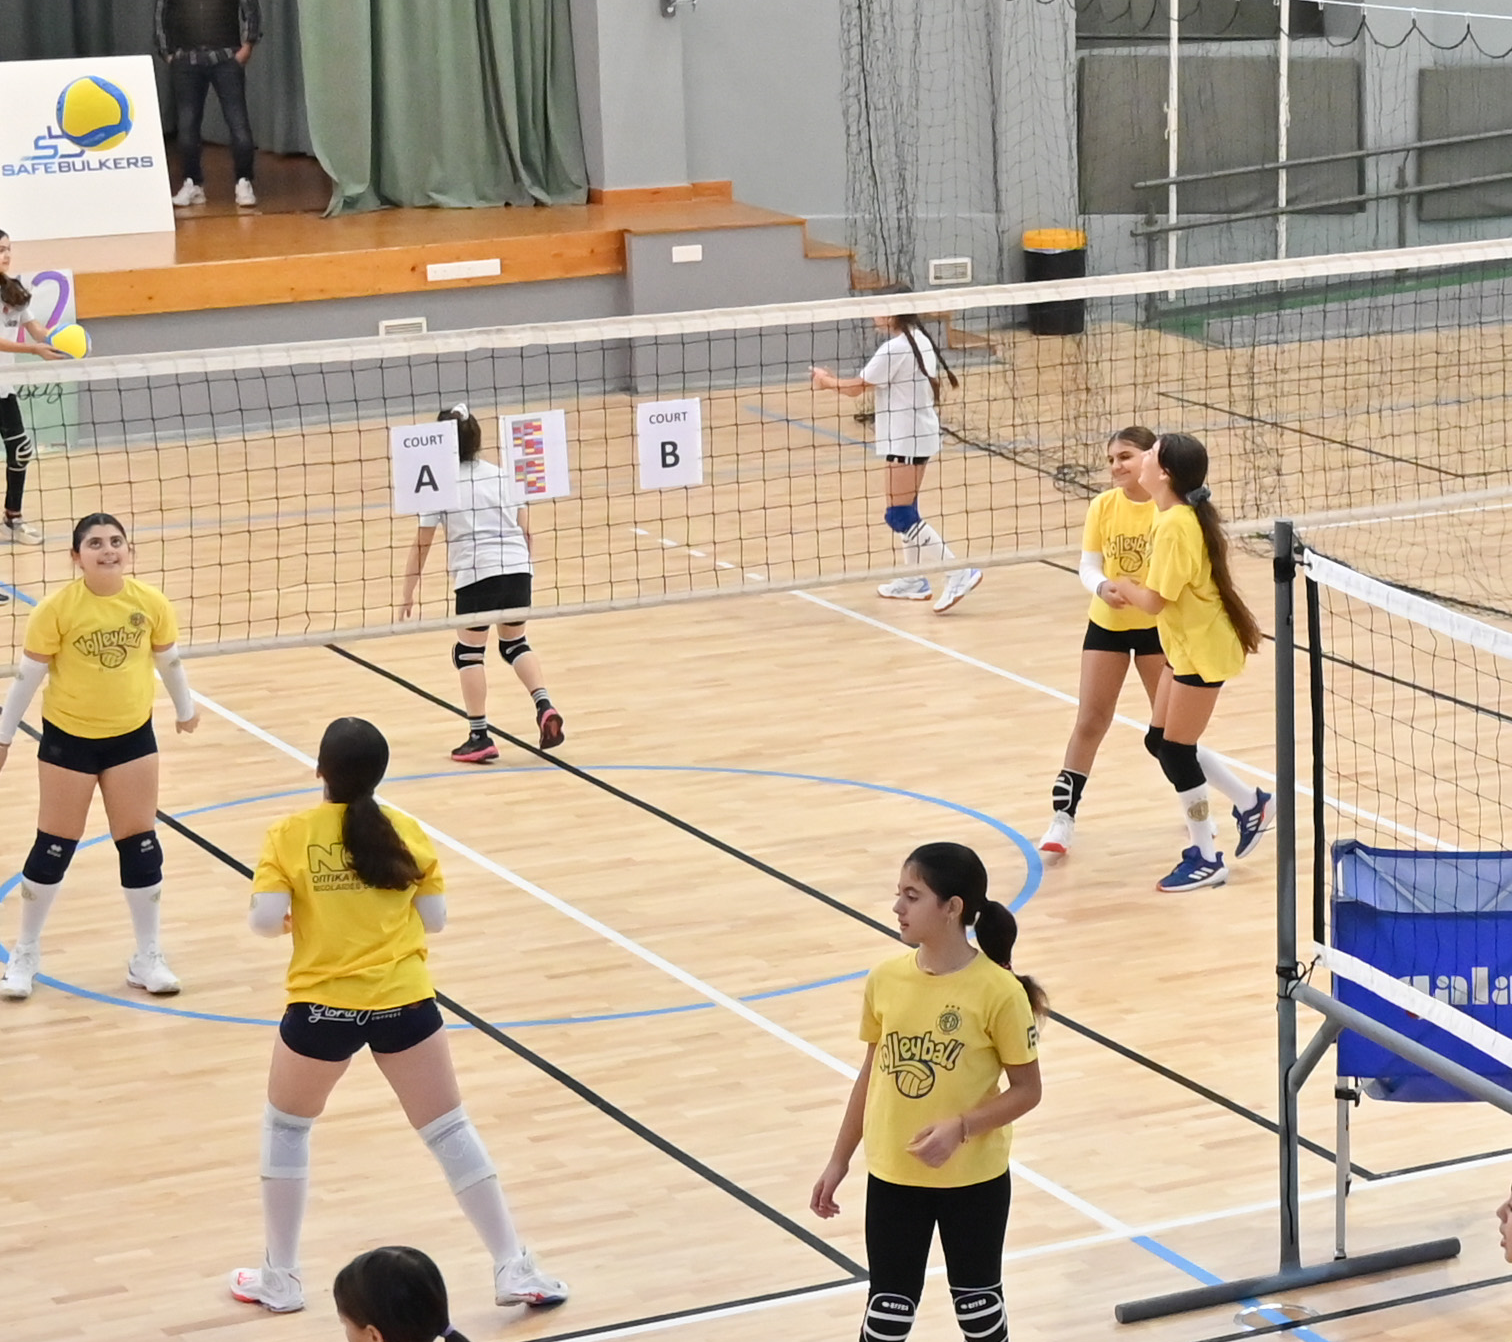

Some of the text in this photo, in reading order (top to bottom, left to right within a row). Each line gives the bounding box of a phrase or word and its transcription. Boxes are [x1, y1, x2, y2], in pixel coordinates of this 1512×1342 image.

[1, 156, 154, 177] SAFEBULKERS
[648, 411, 689, 425] COURT
[402, 434, 445, 449] COURT
[660, 440, 681, 470] B
[414, 464, 440, 494] A
